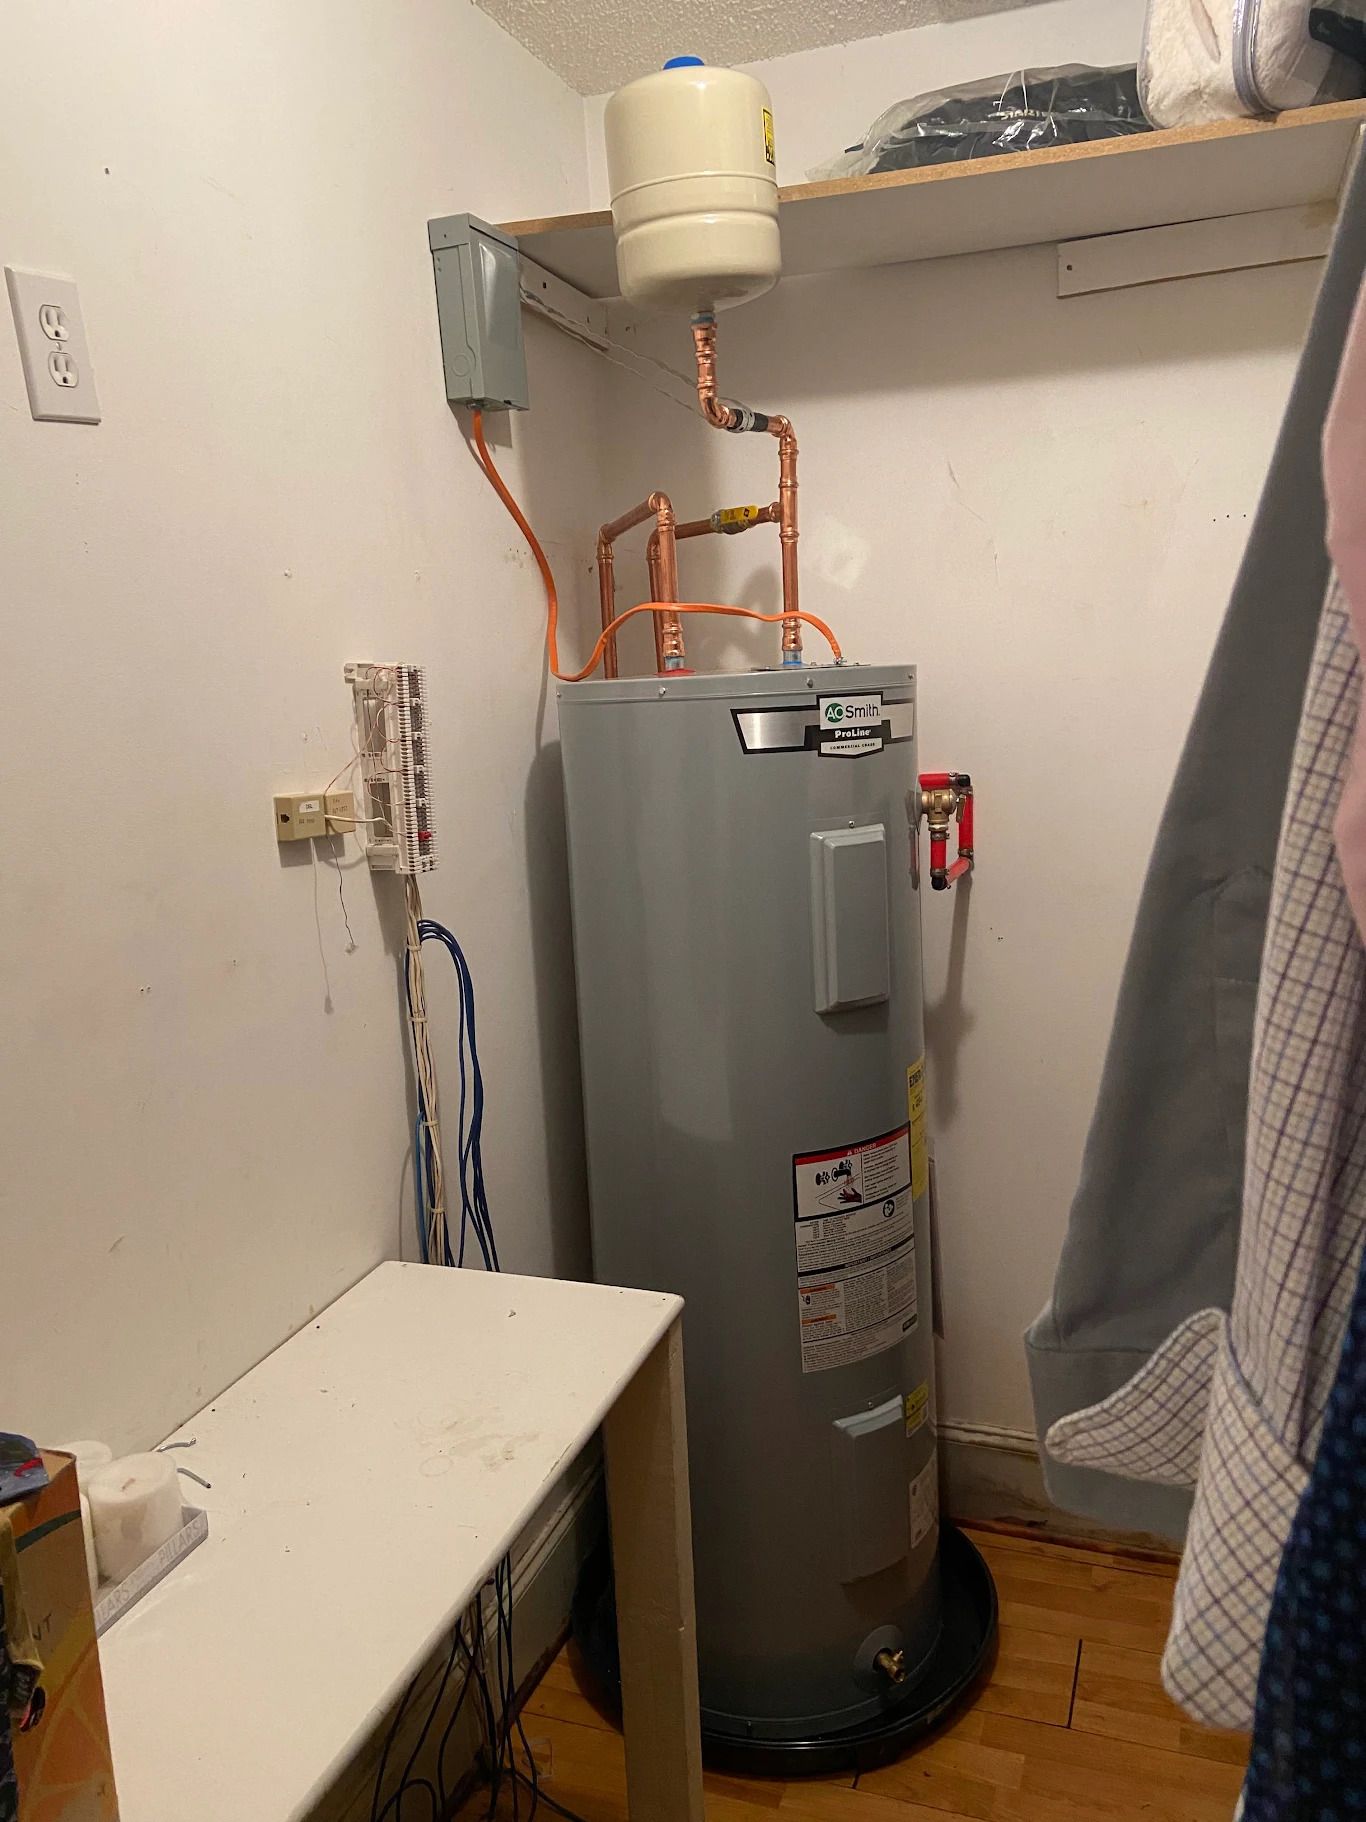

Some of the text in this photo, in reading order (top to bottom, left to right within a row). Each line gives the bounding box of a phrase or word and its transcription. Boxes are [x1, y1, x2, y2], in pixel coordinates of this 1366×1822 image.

[845, 703, 880, 719] Smith
[834, 728, 871, 739] ProLine
[854, 1142, 878, 1154] DANGER
[159, 1520, 201, 1565] PILLARS
